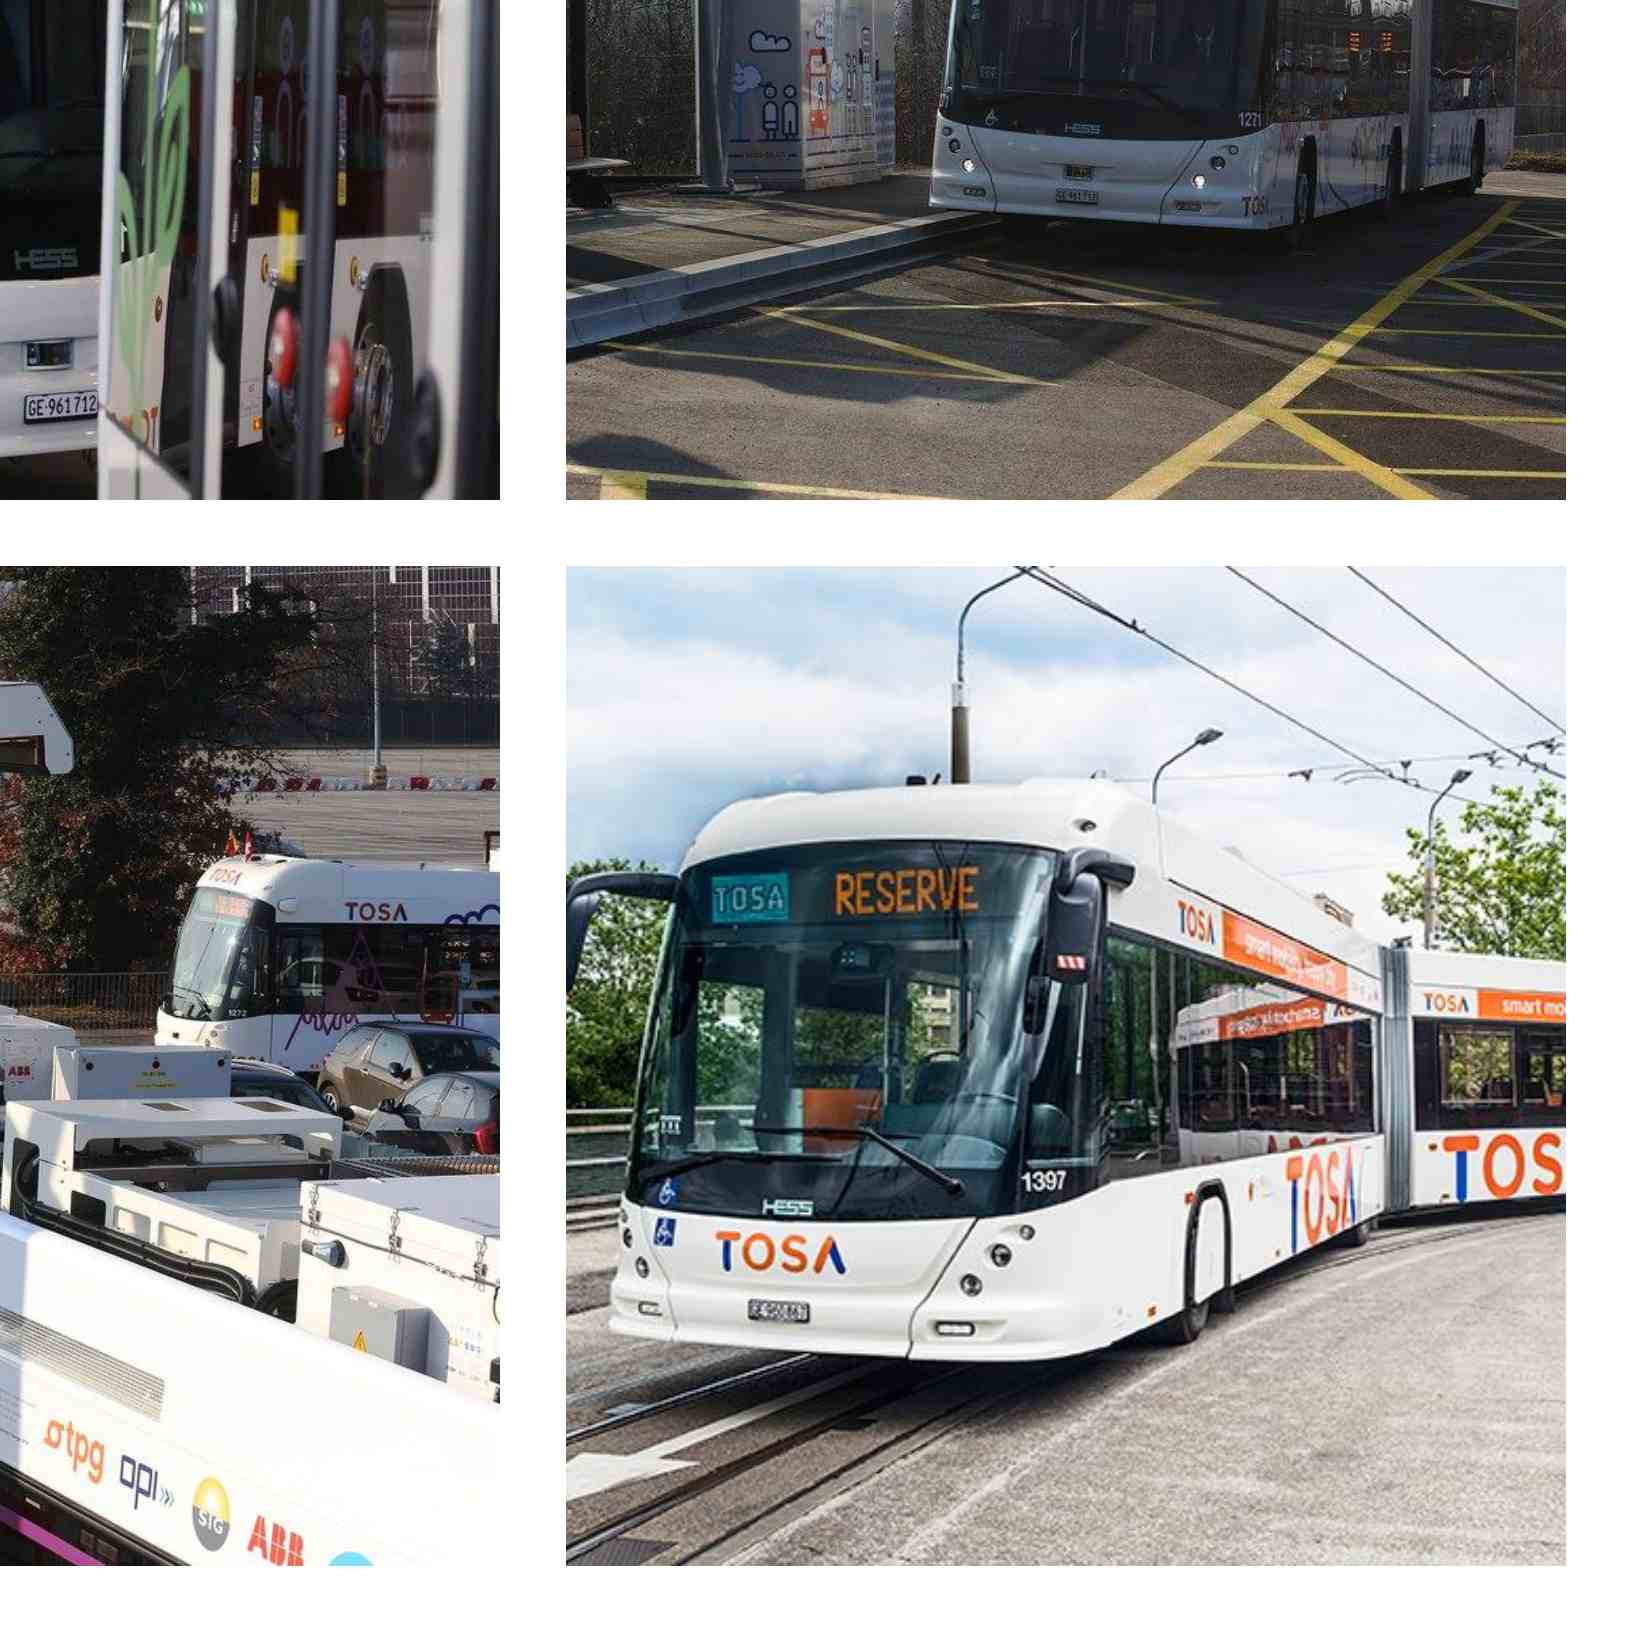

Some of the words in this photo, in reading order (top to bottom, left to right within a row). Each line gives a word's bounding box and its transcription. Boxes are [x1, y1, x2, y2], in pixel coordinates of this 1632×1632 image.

[1238, 111, 1262, 128] 1271
[14, 248, 79, 269] HESS
[716, 886, 783, 912] TOSA
[835, 867, 978, 915] RESERVE
[345, 902, 407, 922] TOSA
[1178, 899, 1216, 944] TOSA
[1424, 992, 1469, 1012] TOSA
[1502, 999, 1542, 1015] smart
[8, 1065, 31, 1077] ABB
[1443, 1132, 1564, 1201] TOS
[1020, 1170, 1067, 1193] 1397
[762, 1199, 814, 1216] HESS
[1286, 1146, 1357, 1254] TOSA
[716, 1231, 846, 1275] TOSA
[197, 1506, 226, 1536] SIG
[247, 1515, 304, 1566] ABB
